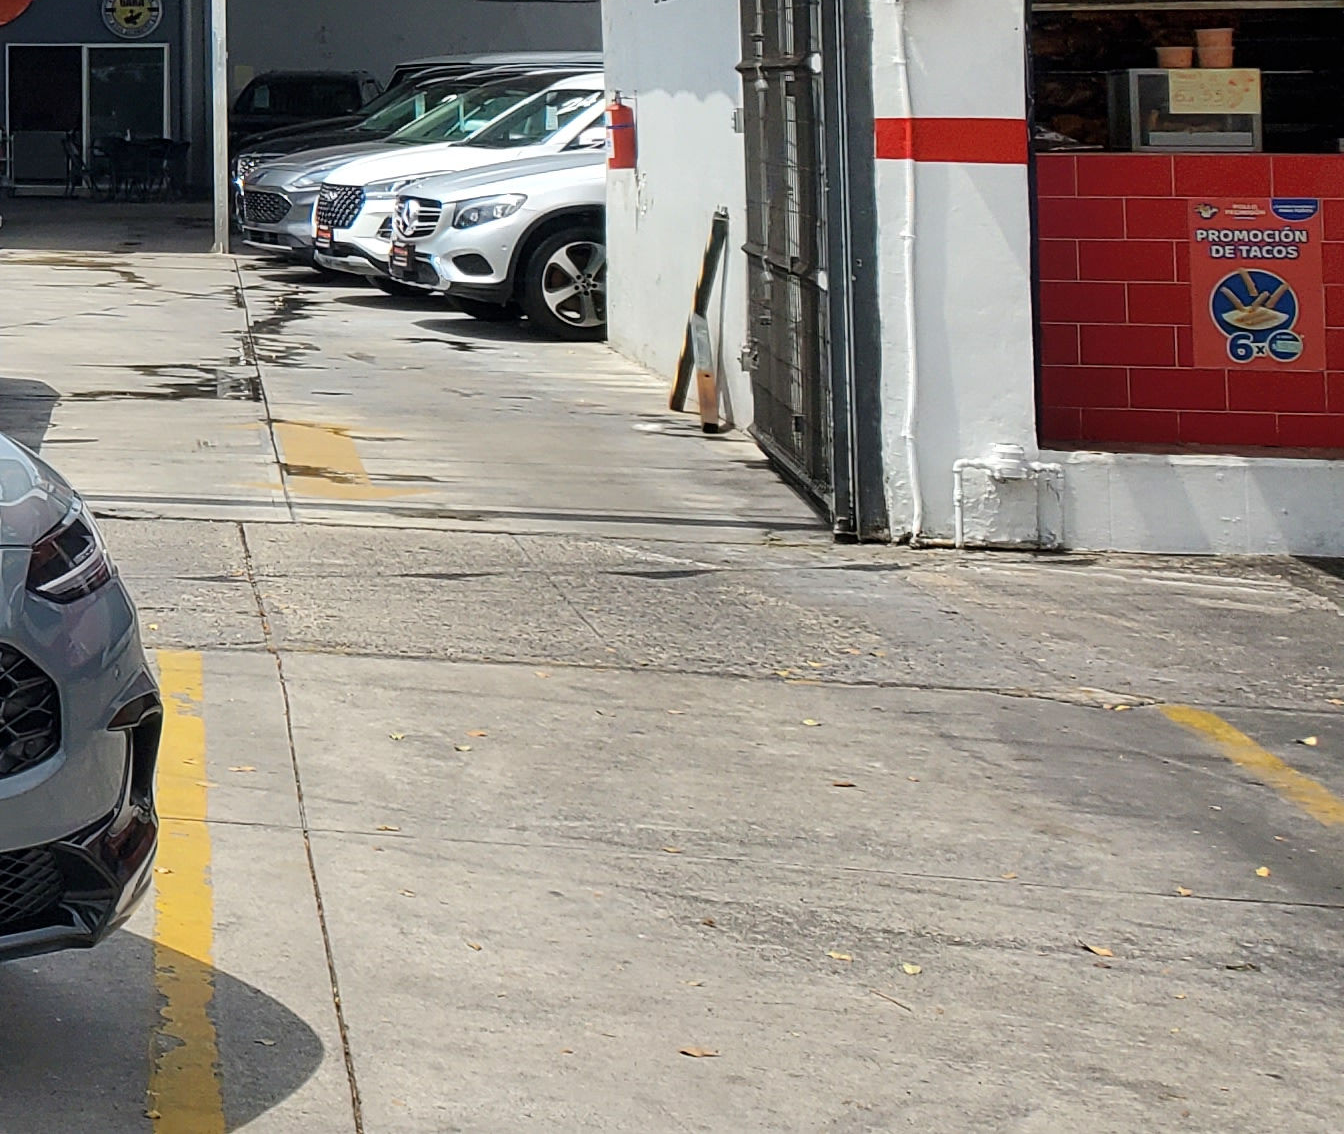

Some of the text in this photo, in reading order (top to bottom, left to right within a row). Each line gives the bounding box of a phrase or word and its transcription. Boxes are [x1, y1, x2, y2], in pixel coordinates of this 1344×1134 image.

[1196, 227, 1308, 243] PROMOCIÓN
[1211, 245, 1299, 259] DE TACOS
[1229, 332, 1255, 362] 6
